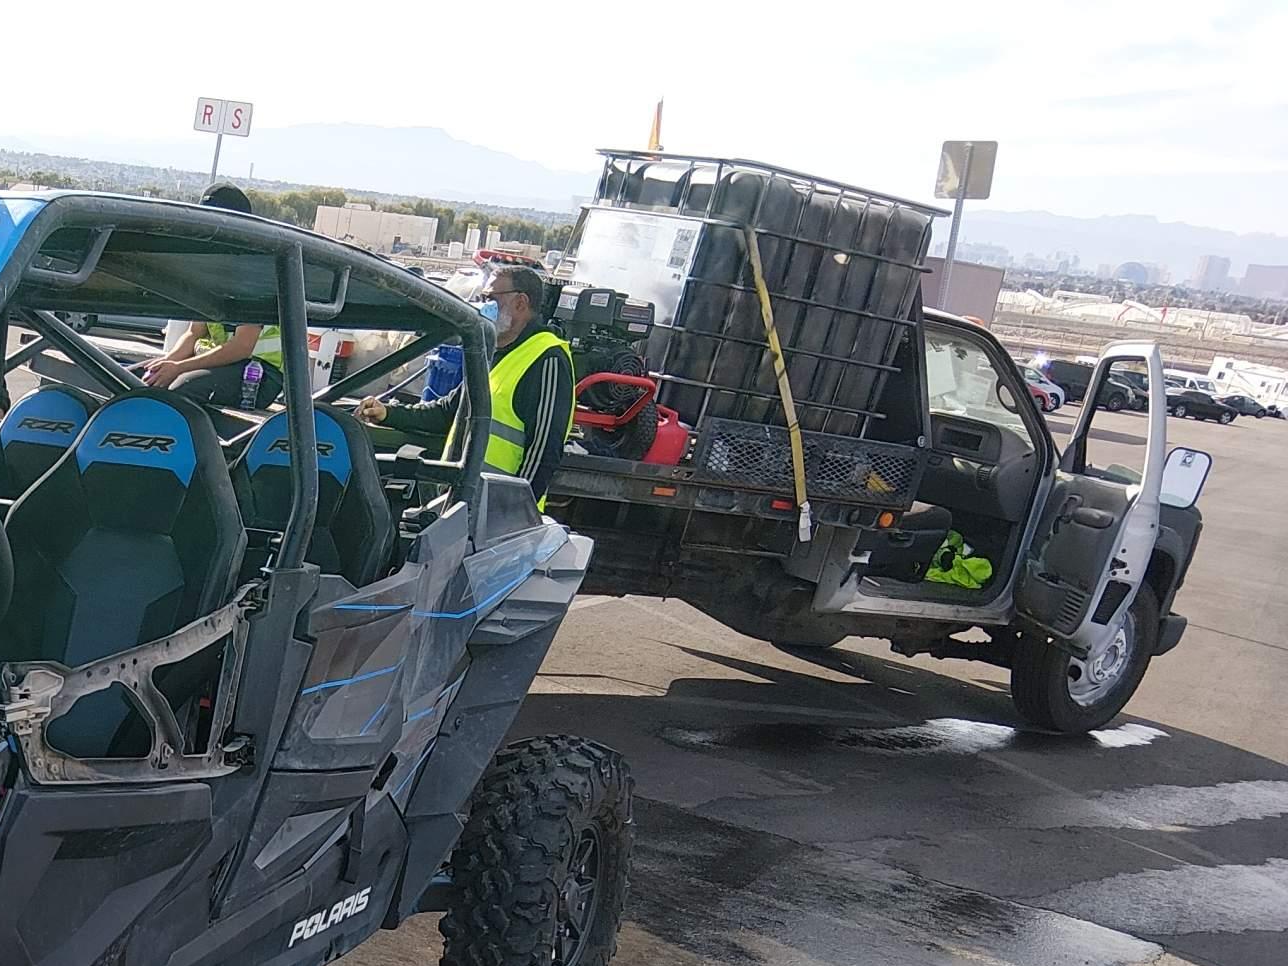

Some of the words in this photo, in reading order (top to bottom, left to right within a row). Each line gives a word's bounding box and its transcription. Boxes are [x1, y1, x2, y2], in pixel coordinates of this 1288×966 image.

[202, 104, 214, 126] R
[231, 108, 243, 129] S
[17, 417, 75, 434] RZR
[98, 432, 177, 453] RZR
[267, 438, 337, 456] RR
[288, 885, 372, 949] POLARIS
